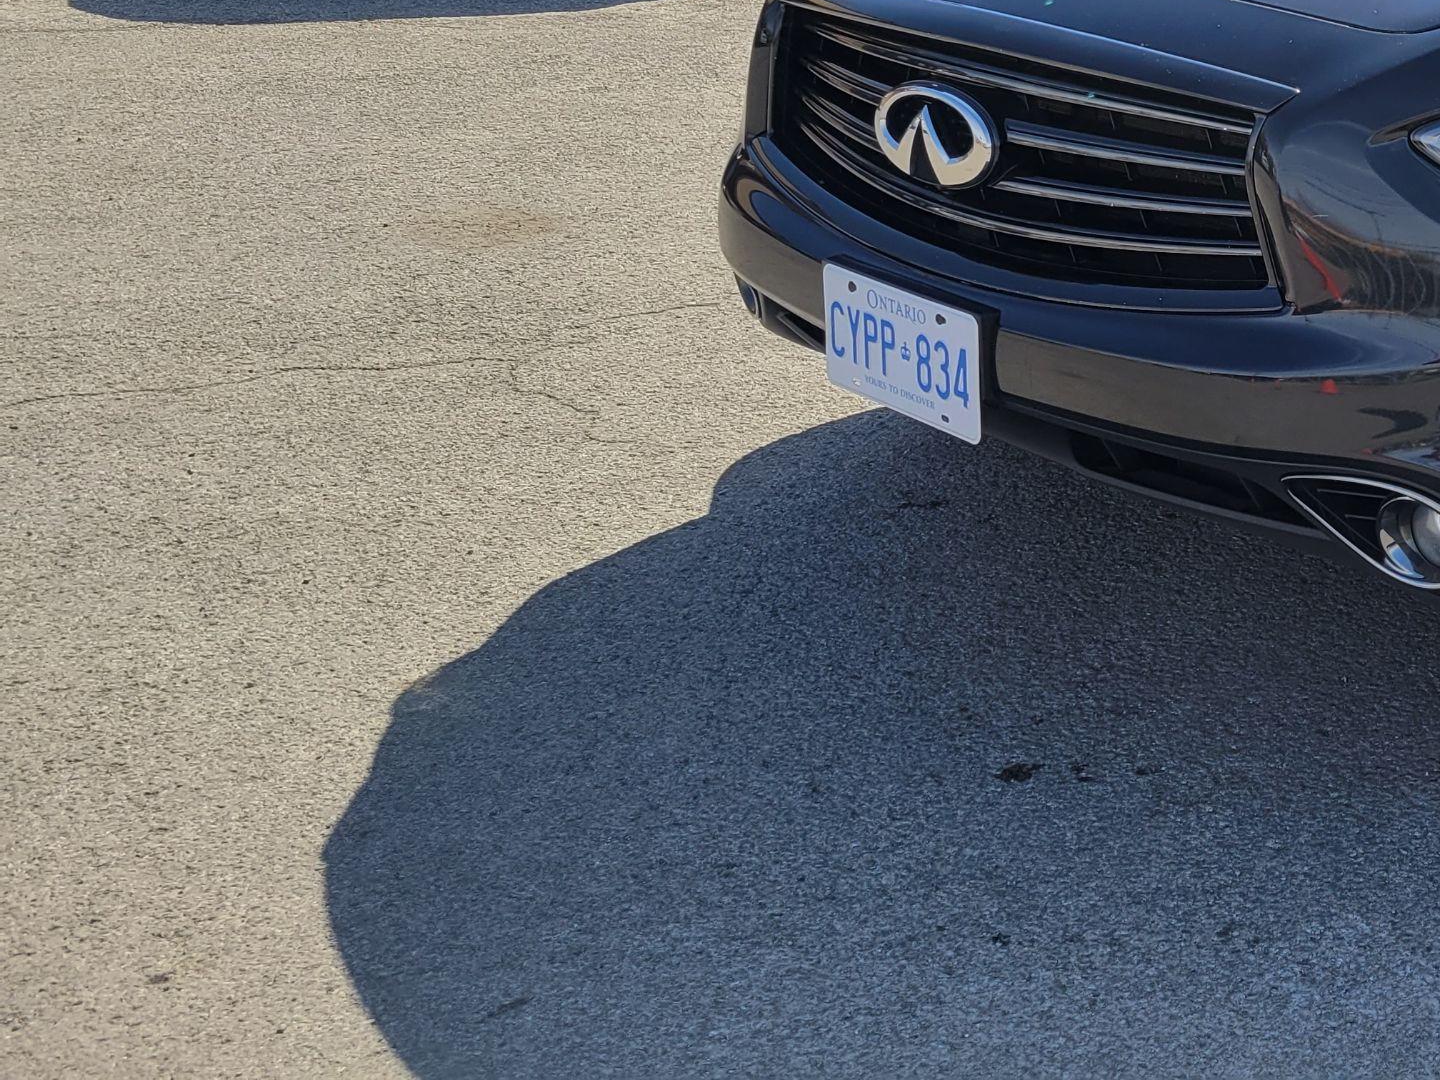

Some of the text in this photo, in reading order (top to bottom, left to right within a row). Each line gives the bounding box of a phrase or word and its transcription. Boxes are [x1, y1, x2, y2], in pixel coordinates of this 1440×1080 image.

[866, 289, 926, 325] ONTARIO
[830, 301, 970, 409] CYPP 834
[888, 383, 899, 395] TO
[900, 388, 935, 410] DISCOVER
